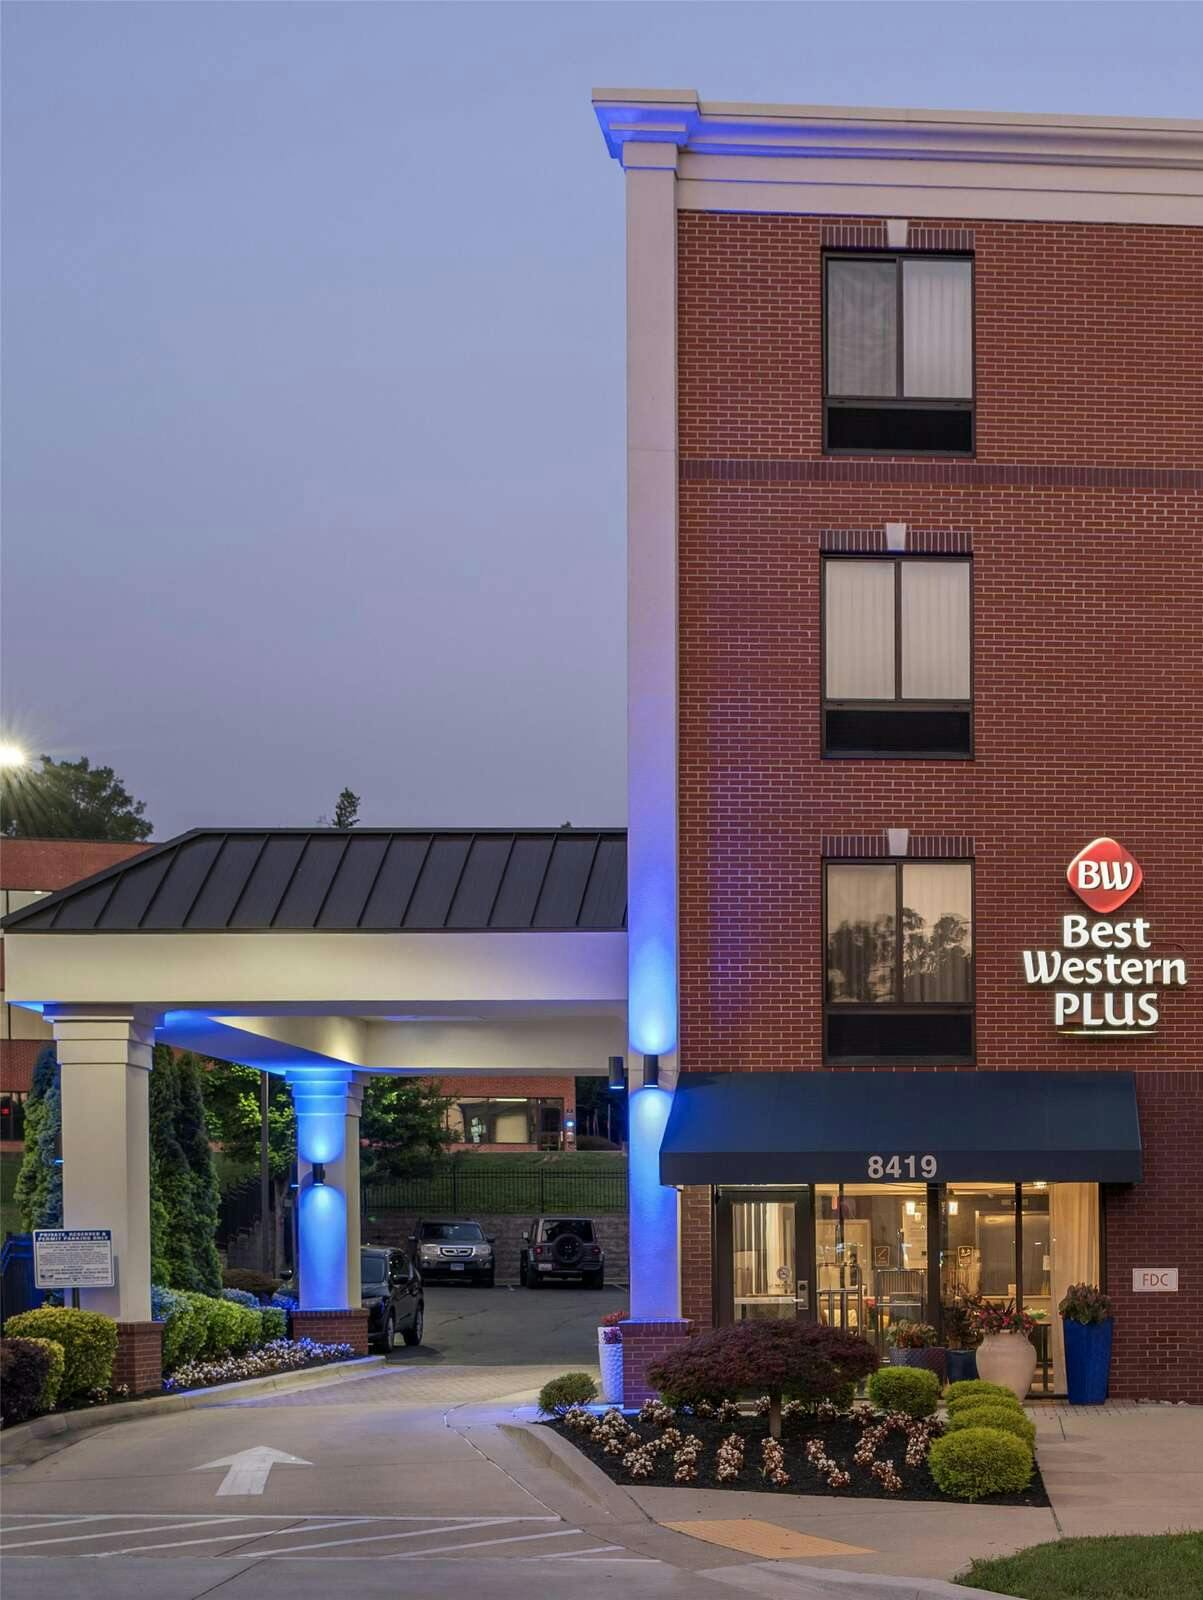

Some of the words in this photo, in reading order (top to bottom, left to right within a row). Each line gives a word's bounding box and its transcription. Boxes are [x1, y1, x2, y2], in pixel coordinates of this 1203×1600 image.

[1078, 861, 1134, 891] BW
[1063, 915, 1152, 948] Best
[1023, 951, 1188, 985] Western
[1055, 992, 1159, 1026] PLUS
[868, 1155, 938, 1179] 8419
[1143, 1273, 1169, 1287] FDC
